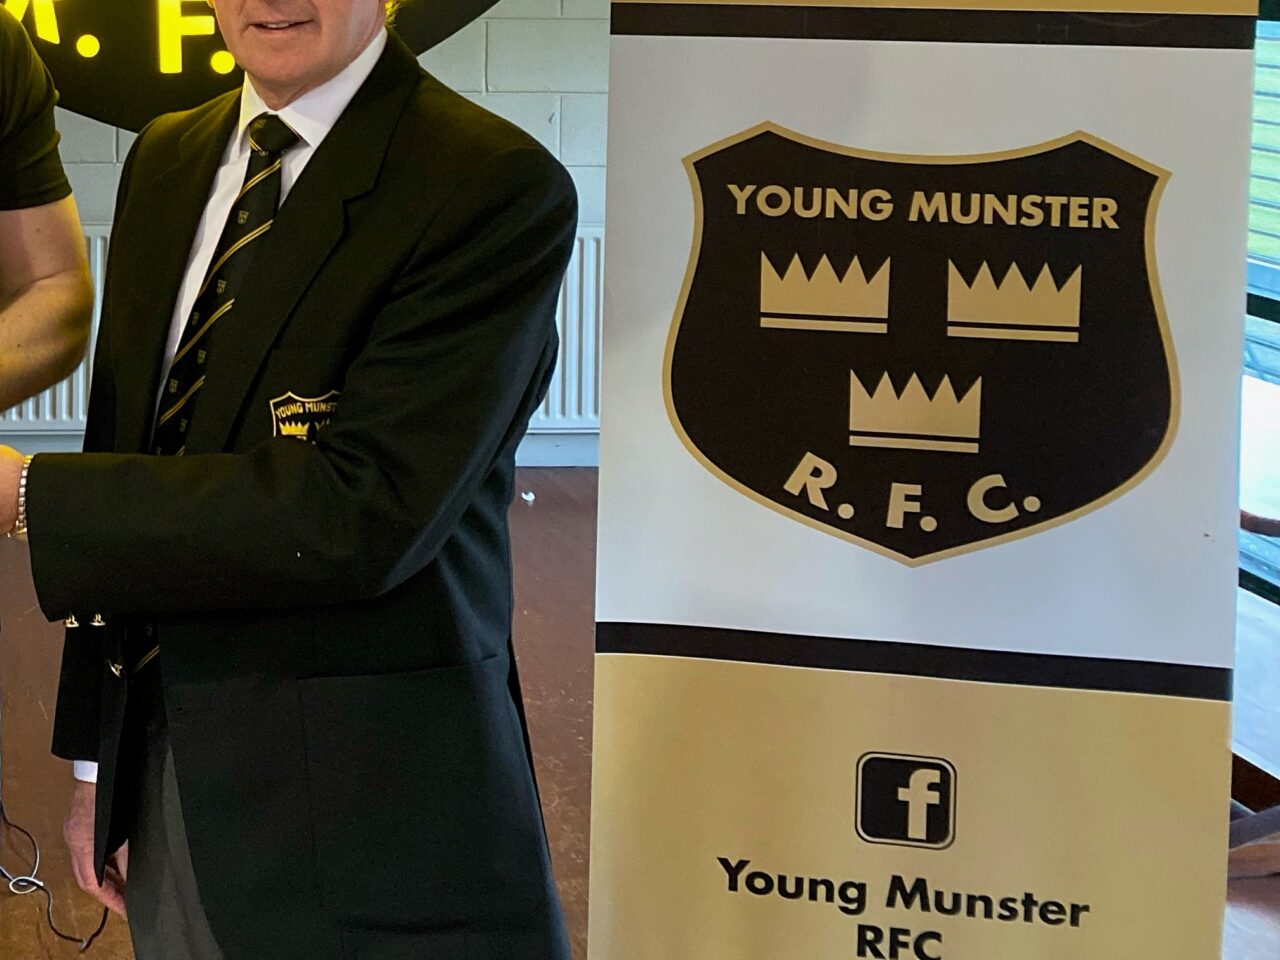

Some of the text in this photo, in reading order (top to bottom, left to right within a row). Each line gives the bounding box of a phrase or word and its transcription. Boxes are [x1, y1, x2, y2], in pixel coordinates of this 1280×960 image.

[727, 184, 1120, 230] YOUNG MUNSTER
[275, 401, 338, 419] YOUNG MUNST
[716, 856, 1091, 928] Young Munster
[856, 923, 943, 960] RFC
